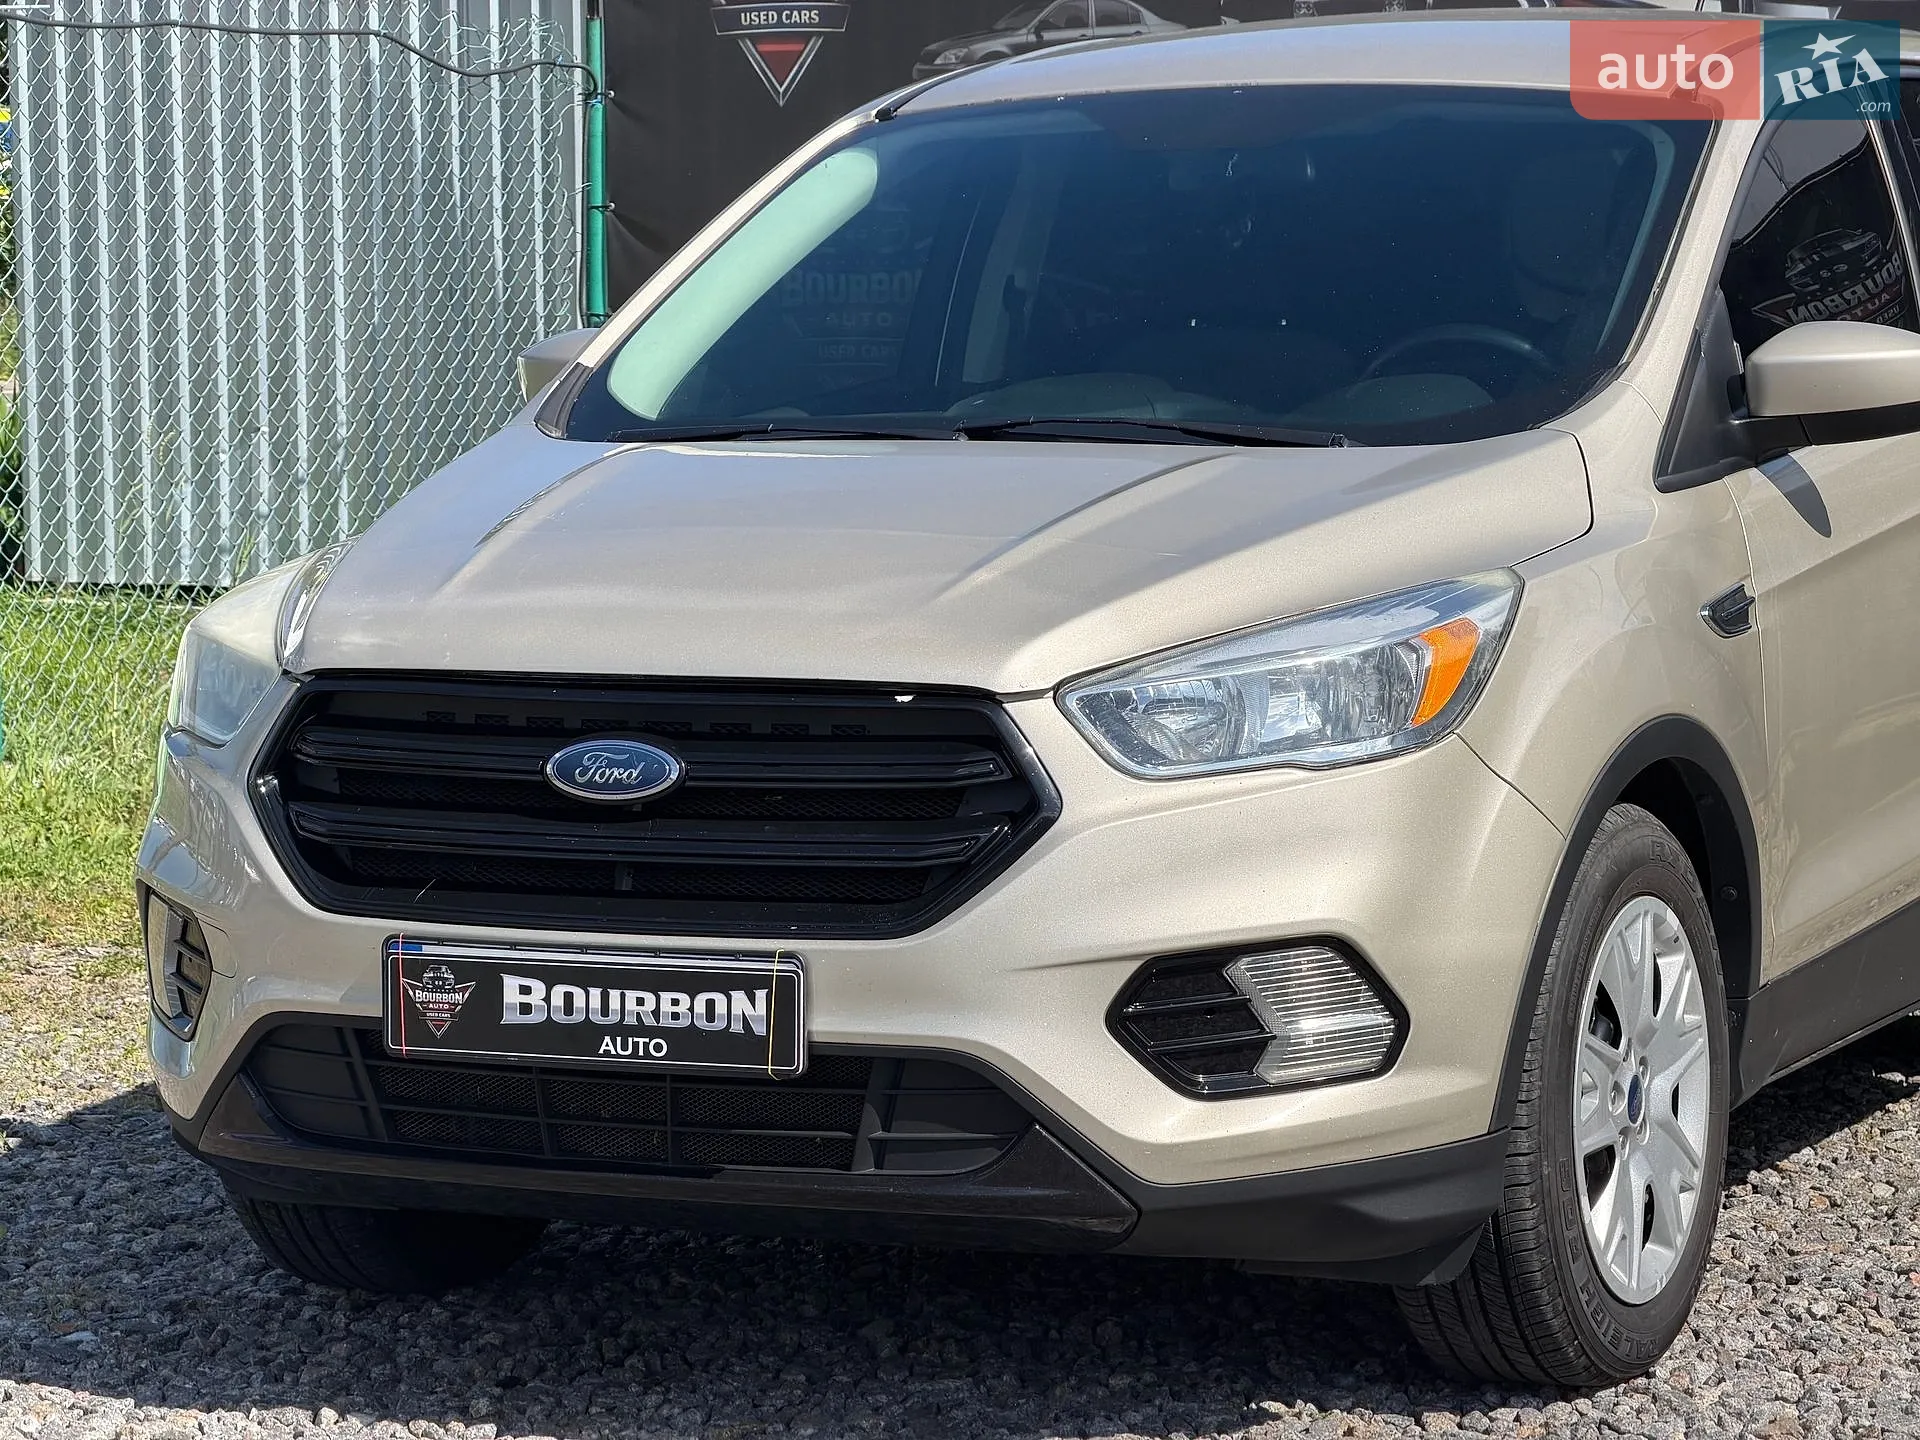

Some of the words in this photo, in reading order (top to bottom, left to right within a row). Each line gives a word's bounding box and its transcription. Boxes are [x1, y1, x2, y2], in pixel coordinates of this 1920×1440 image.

[741, 10, 778, 26] USED
[782, 9, 820, 24] CARS
[574, 751, 646, 785] Ford
[415, 989, 463, 1004] BOURBON
[499, 973, 769, 1037] BOURBON
[598, 1036, 669, 1058] AUTO
